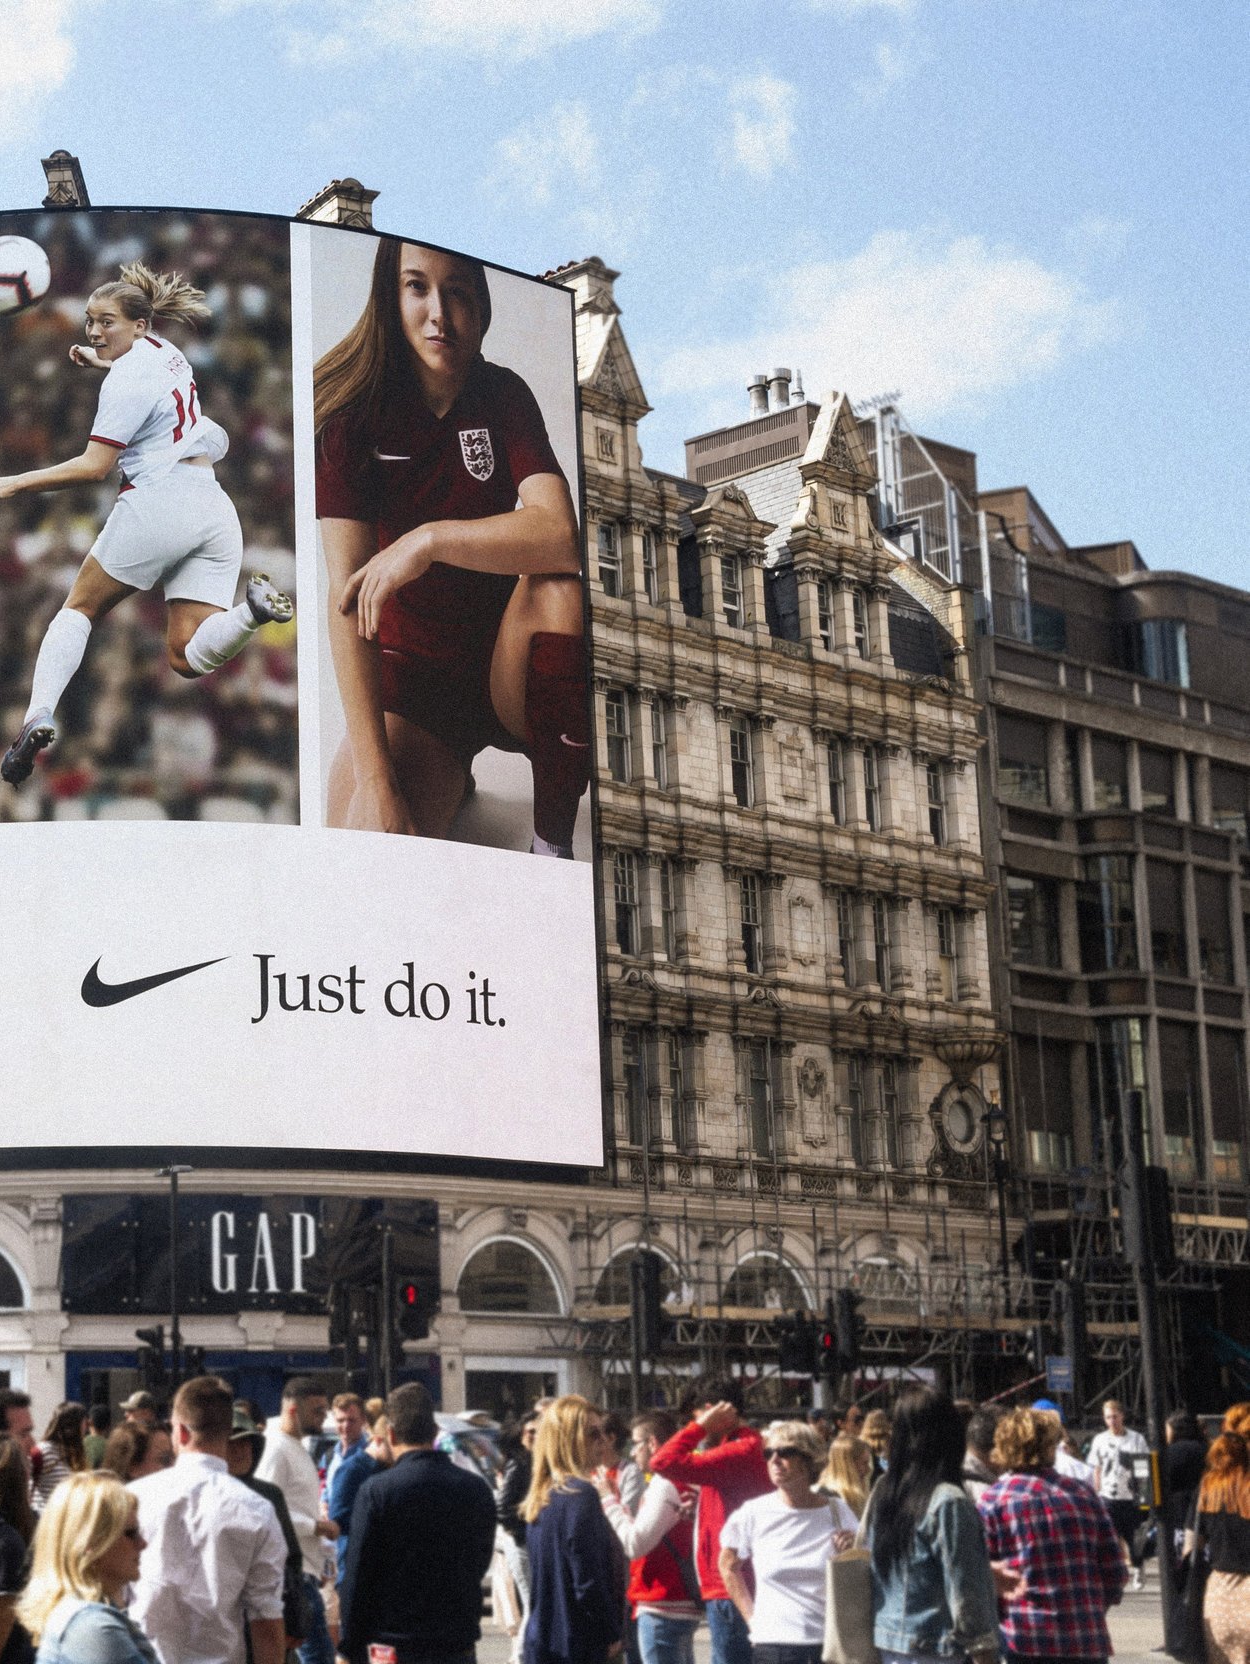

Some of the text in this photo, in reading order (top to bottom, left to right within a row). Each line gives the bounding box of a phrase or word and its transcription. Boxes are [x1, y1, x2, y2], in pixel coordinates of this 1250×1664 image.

[251, 953, 506, 1027] Just do it.
[211, 1210, 317, 1293] GAP
